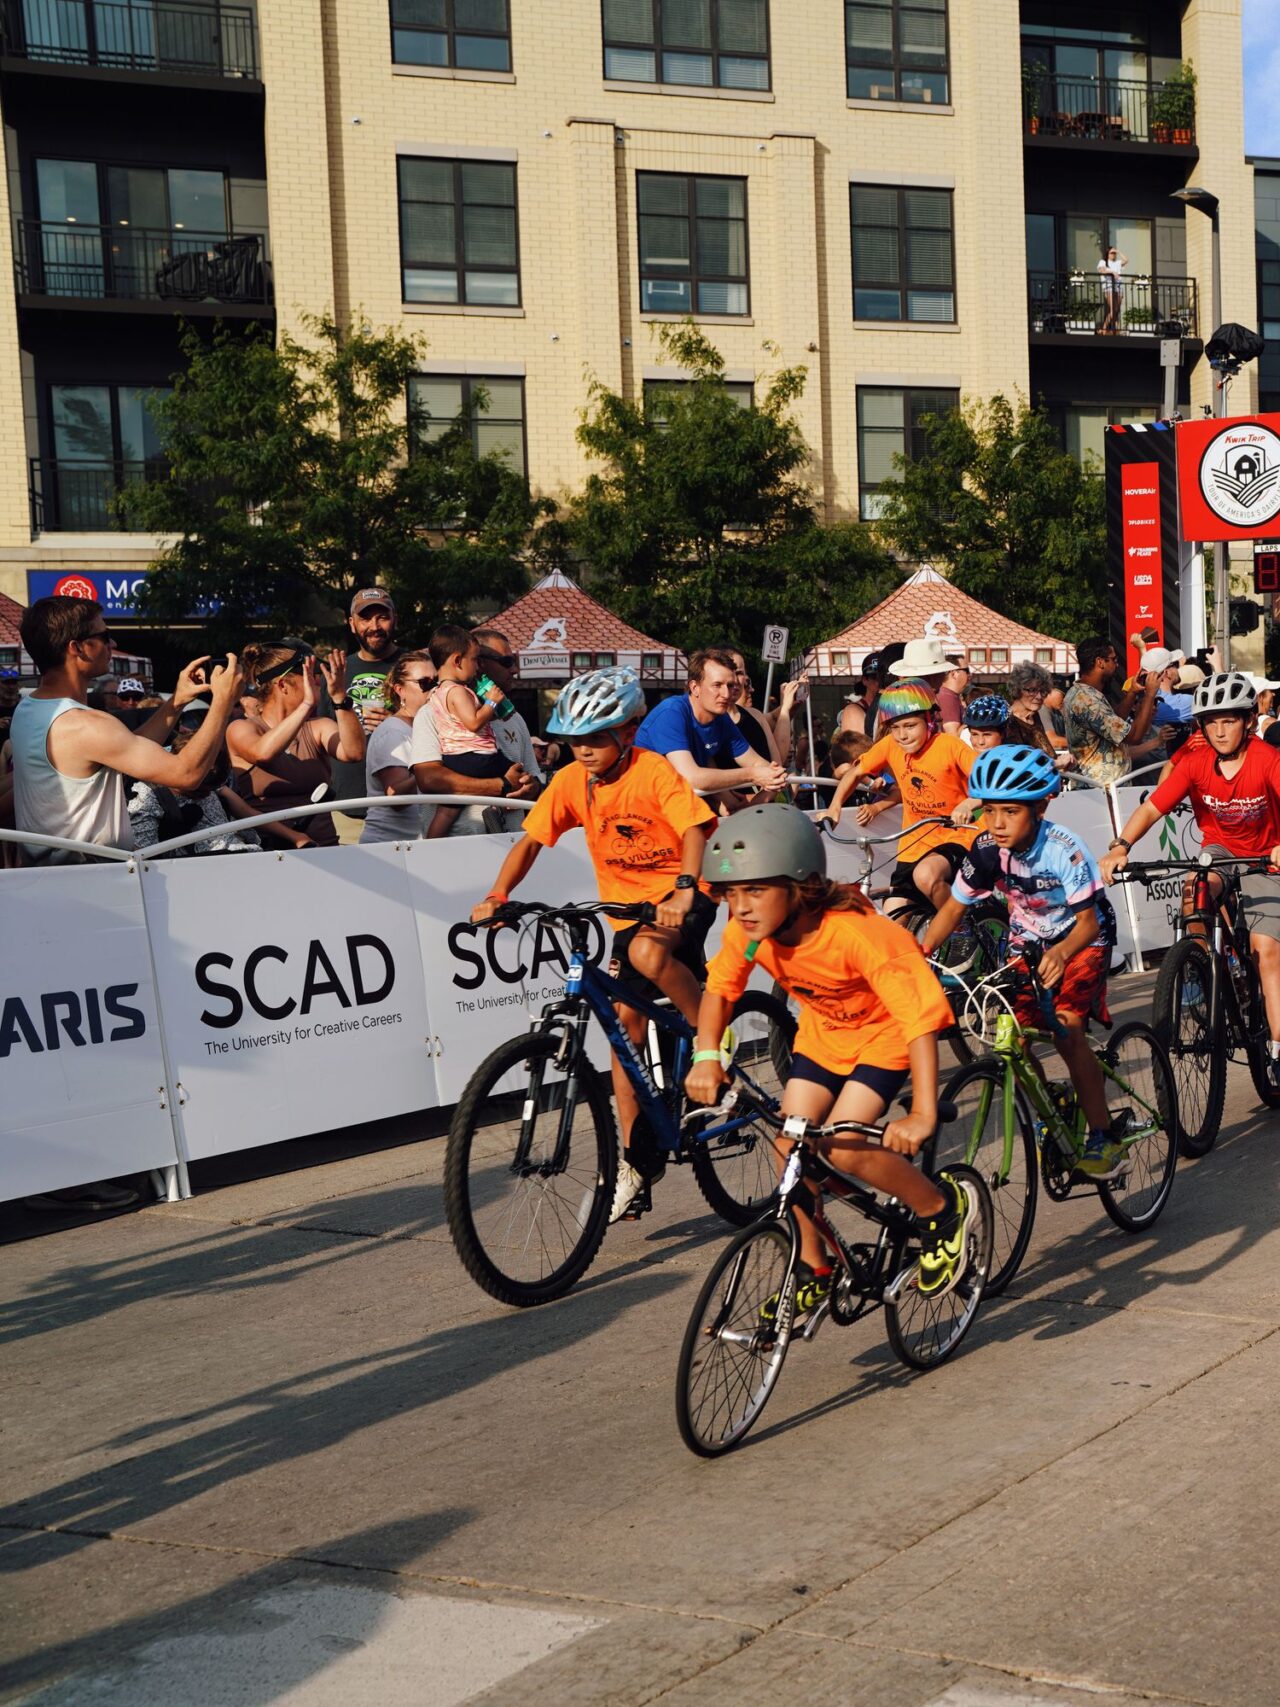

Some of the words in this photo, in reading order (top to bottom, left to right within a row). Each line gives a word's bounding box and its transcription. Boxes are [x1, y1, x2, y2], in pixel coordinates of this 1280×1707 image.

[1208, 483, 1219, 500] TOUR
[1218, 501, 1226, 509] OF
[1260, 544, 1278, 552] LAPS
[628, 847, 674, 864] VILLAGE
[195, 934, 396, 1029] SCAD
[456, 1001, 476, 1014] The
[476, 993, 524, 1011] University
[526, 990, 539, 1001] for
[205, 1040, 229, 1055] The
[232, 1031, 291, 1052] University
[294, 1026, 311, 1041] for
[314, 1018, 360, 1038] Creative
[362, 1012, 403, 1029] Careers
